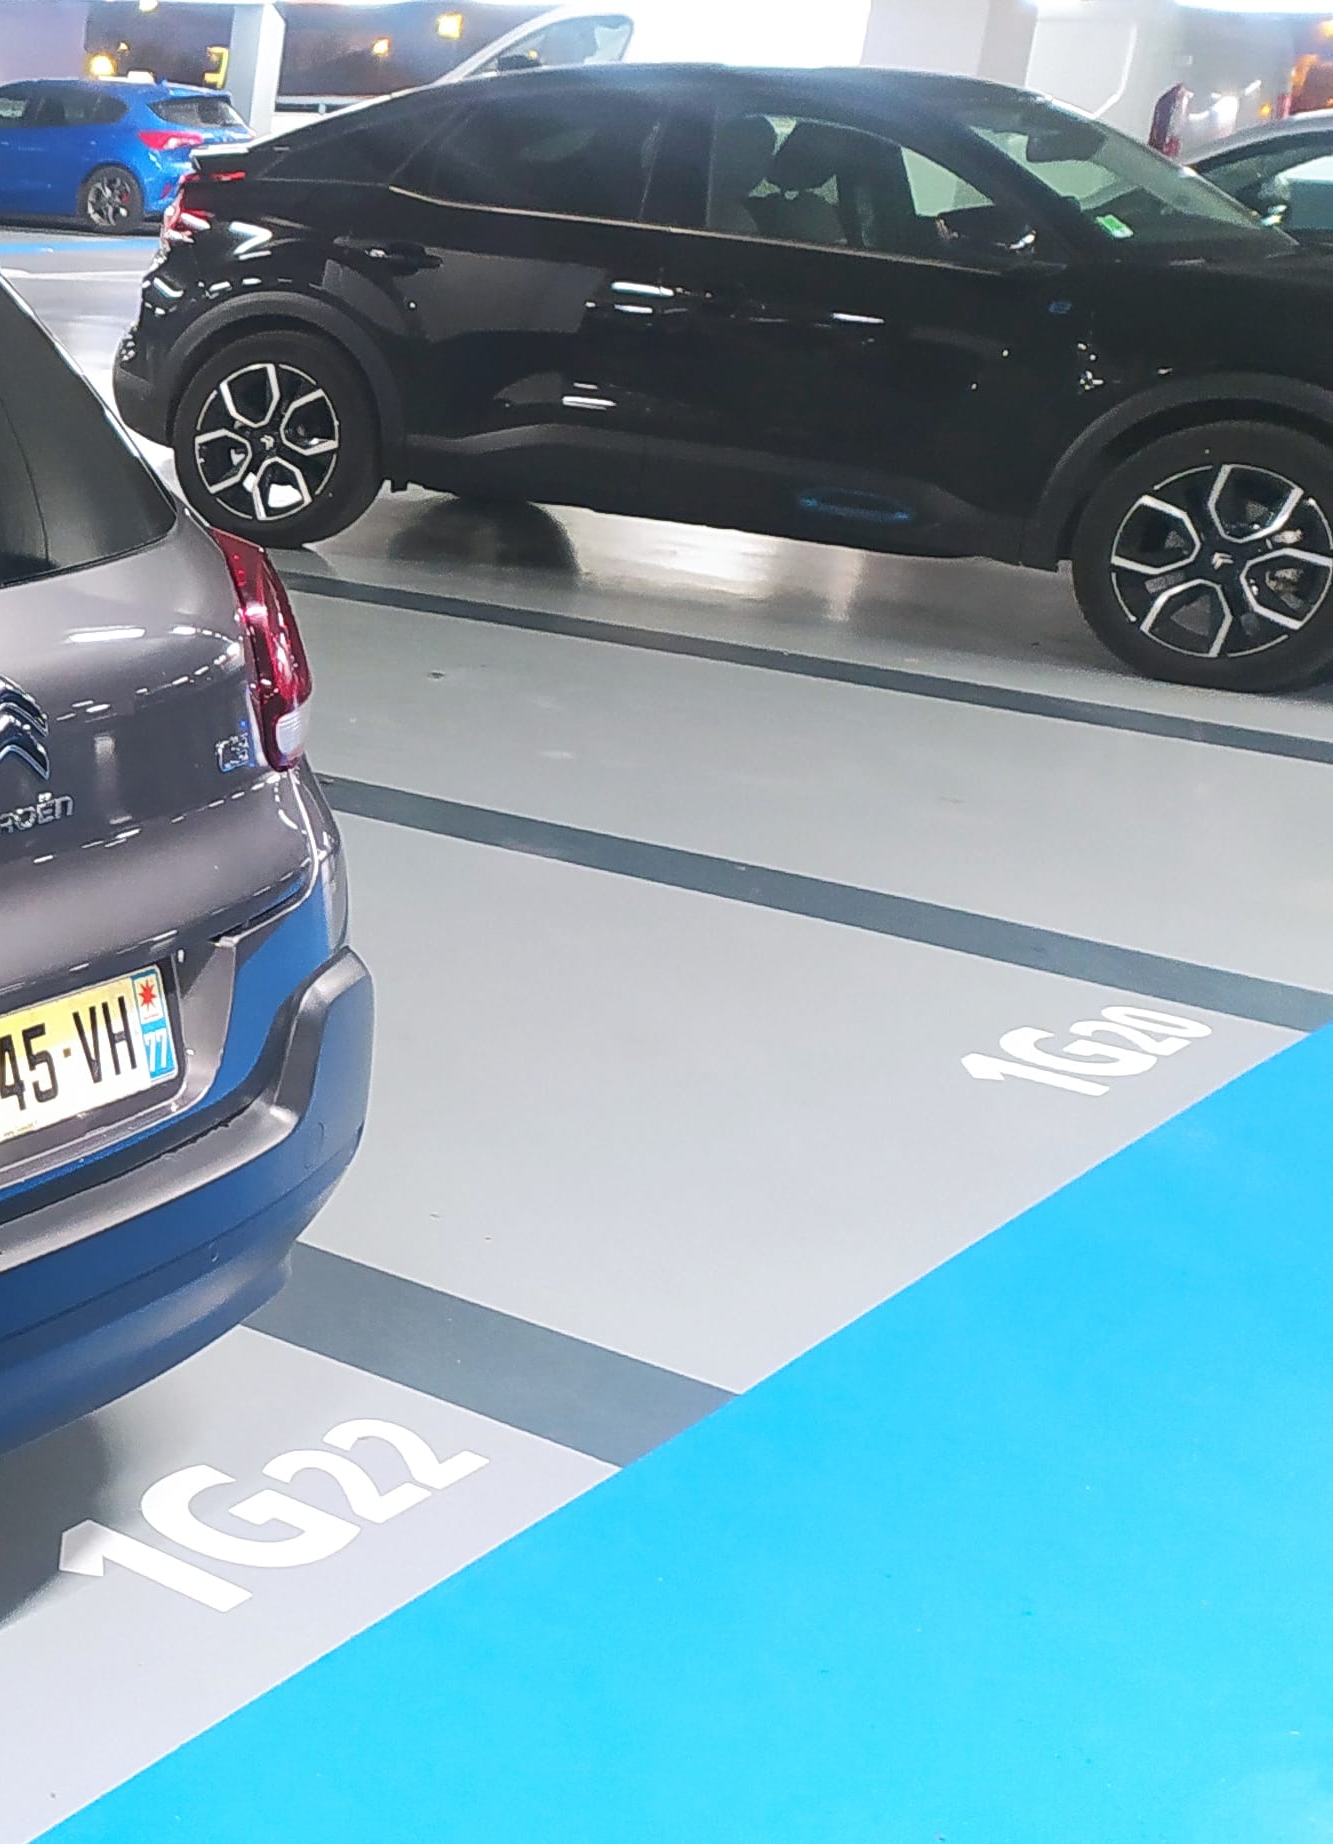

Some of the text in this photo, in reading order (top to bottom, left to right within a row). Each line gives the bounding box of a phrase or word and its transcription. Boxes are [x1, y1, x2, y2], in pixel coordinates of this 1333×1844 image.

[142, 1029, 169, 1073] 77
[960, 1006, 1213, 1097] 1G20
[59, 1418, 491, 1613] 1G22
